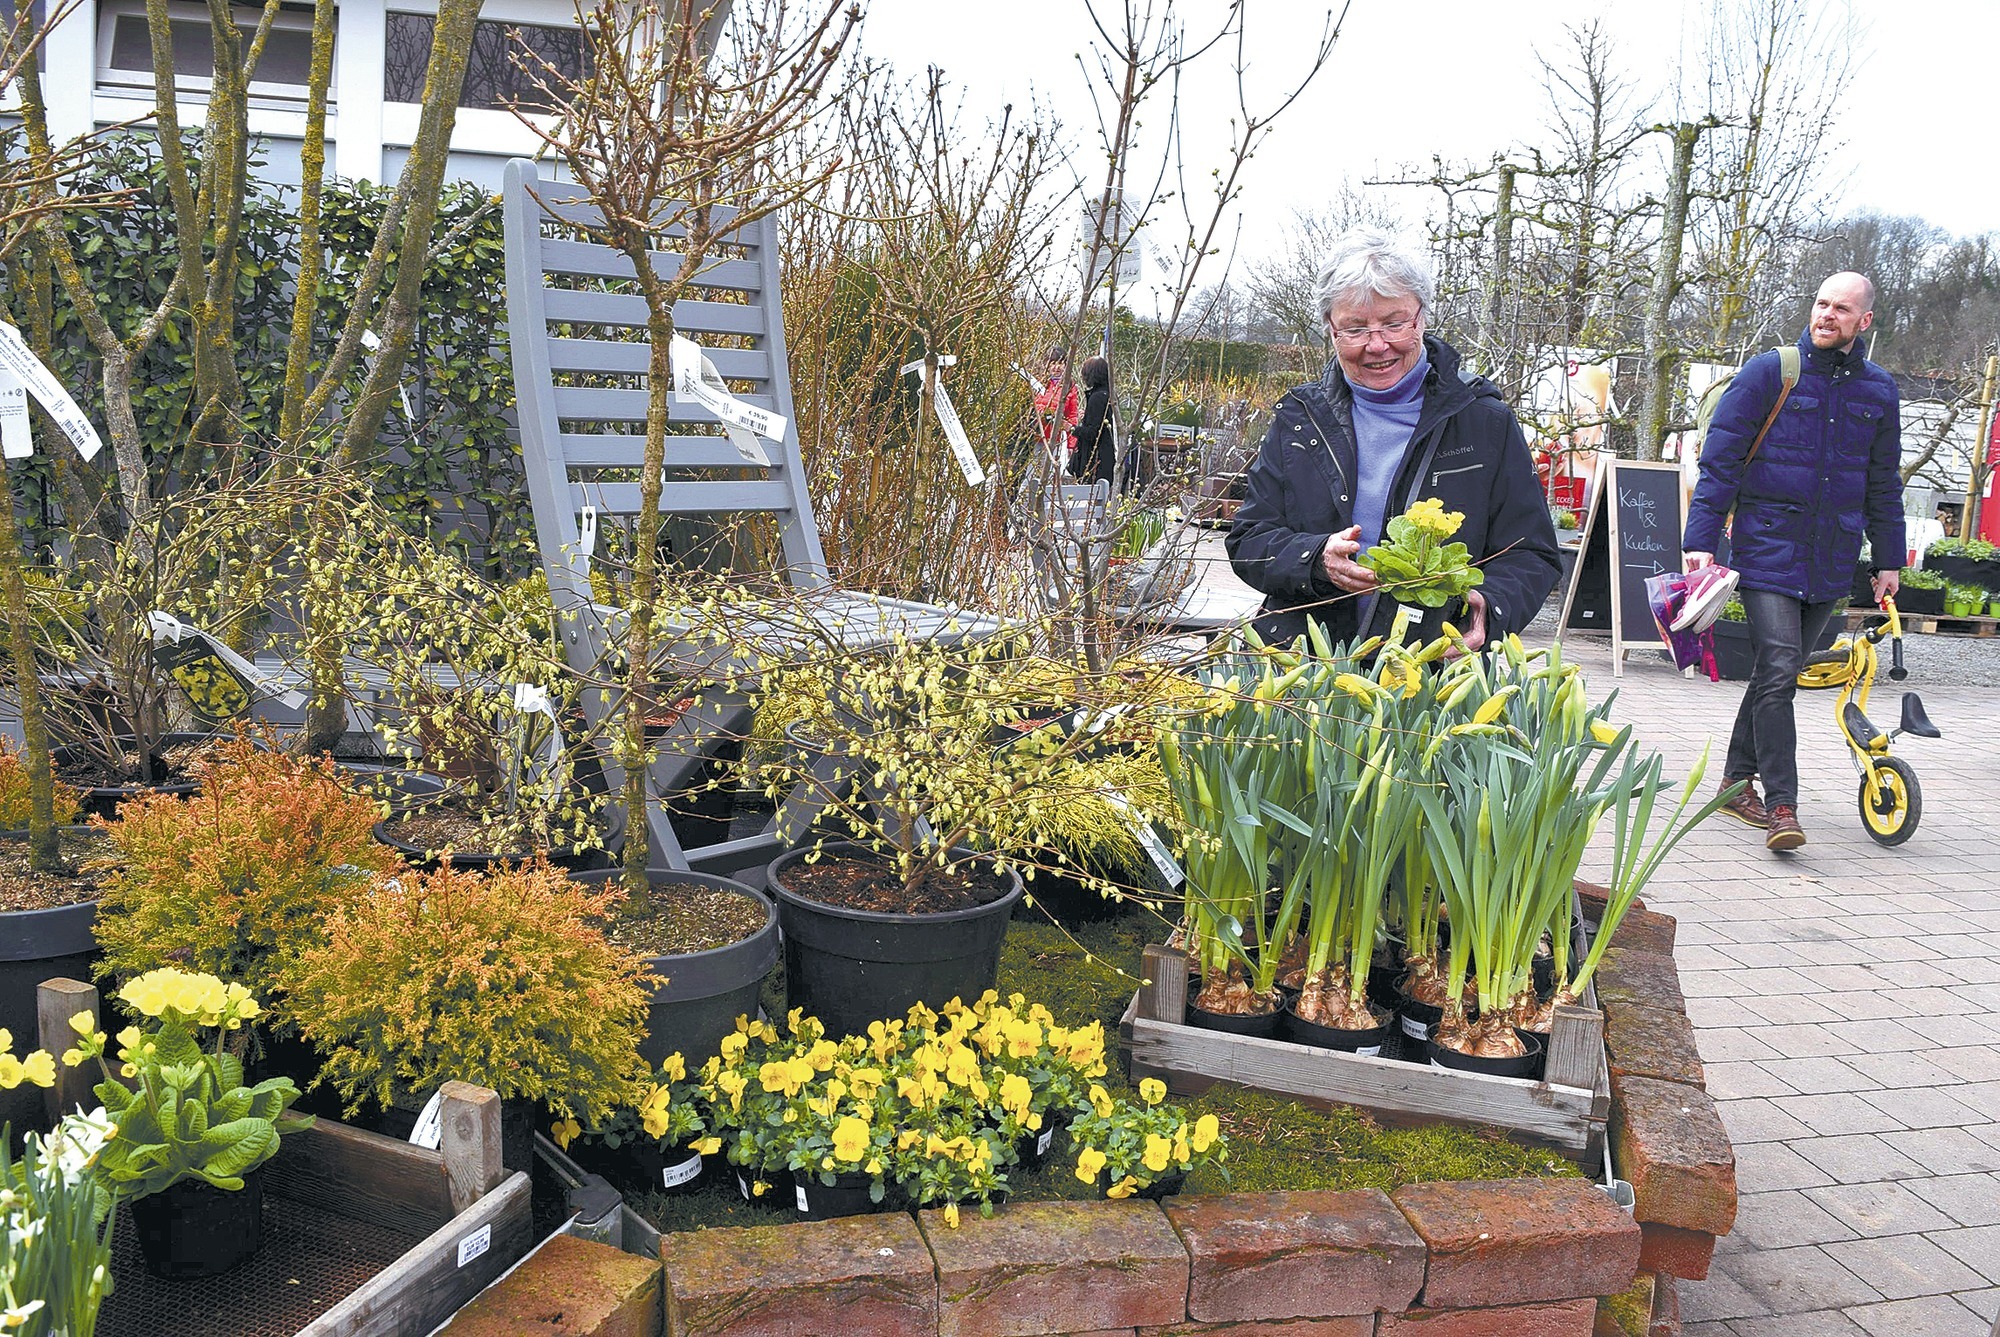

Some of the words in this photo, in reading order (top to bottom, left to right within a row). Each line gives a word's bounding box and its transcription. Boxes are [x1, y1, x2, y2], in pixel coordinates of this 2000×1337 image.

[1619, 487, 1656, 523] Kaffee
[1643, 512, 1657, 528] &
[1623, 532, 1670, 551] Kuchen
